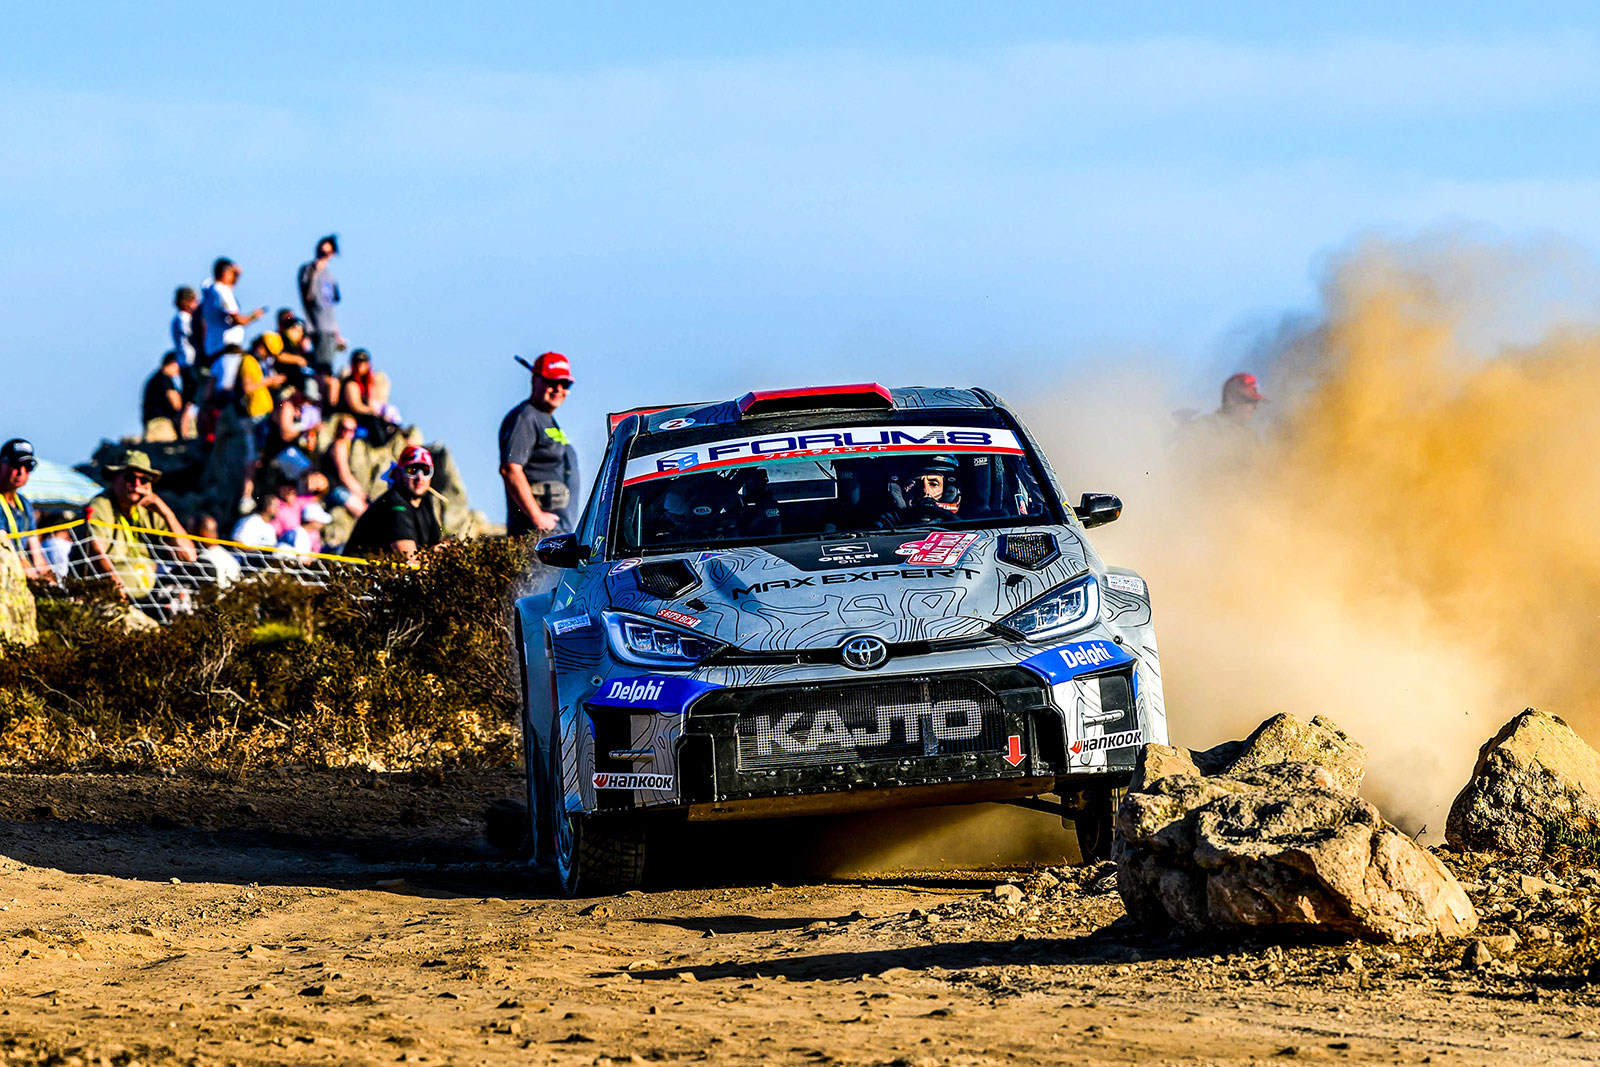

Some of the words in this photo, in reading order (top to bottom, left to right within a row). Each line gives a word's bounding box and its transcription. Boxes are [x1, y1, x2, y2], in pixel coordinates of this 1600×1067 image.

[708, 430, 993, 461] FORUM8
[818, 553, 879, 562] ORLEN
[732, 576, 816, 600] MAX
[821, 568, 981, 585] EXPERT
[1058, 642, 1114, 669] Delphi
[606, 680, 665, 703] Delphi
[756, 700, 982, 756] KAJTO
